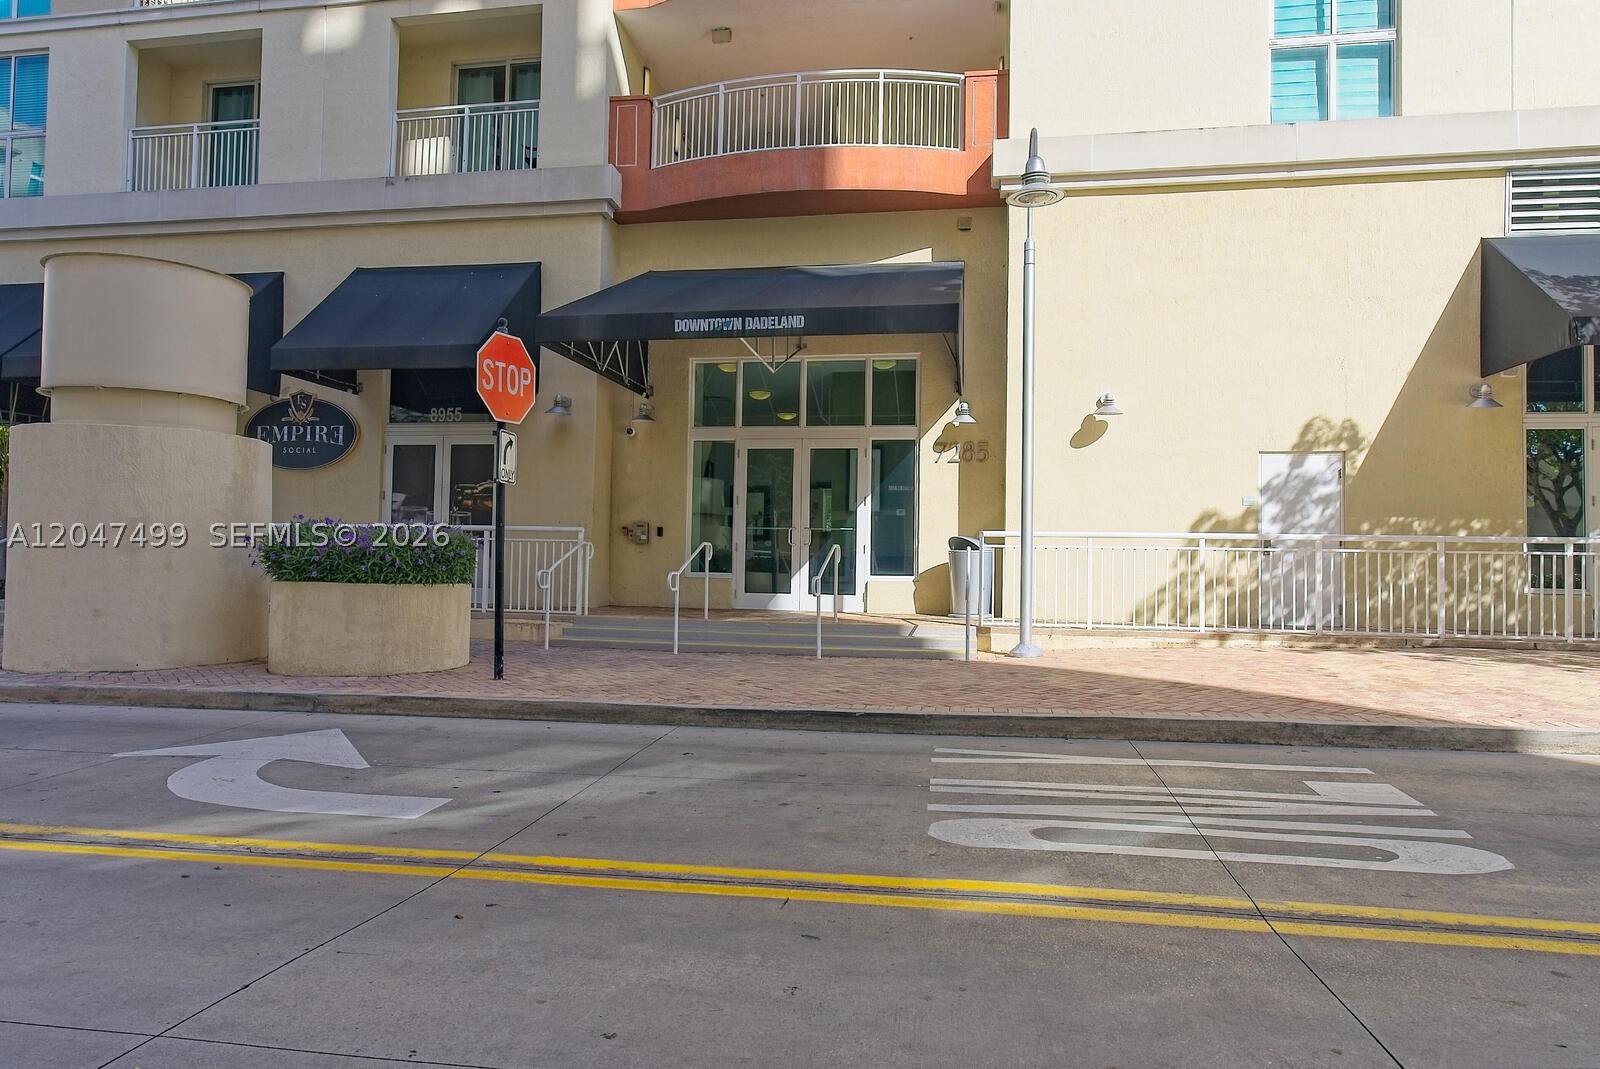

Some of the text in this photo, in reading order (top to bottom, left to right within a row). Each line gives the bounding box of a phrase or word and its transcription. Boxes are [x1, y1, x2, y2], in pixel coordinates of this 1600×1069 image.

[674, 315, 805, 332] DOWNTOWN DADELAND
[481, 358, 532, 397] STOP
[430, 407, 462, 422] 8955
[283, 446, 316, 455] SOCIAL
[501, 467, 516, 483] ONLY
